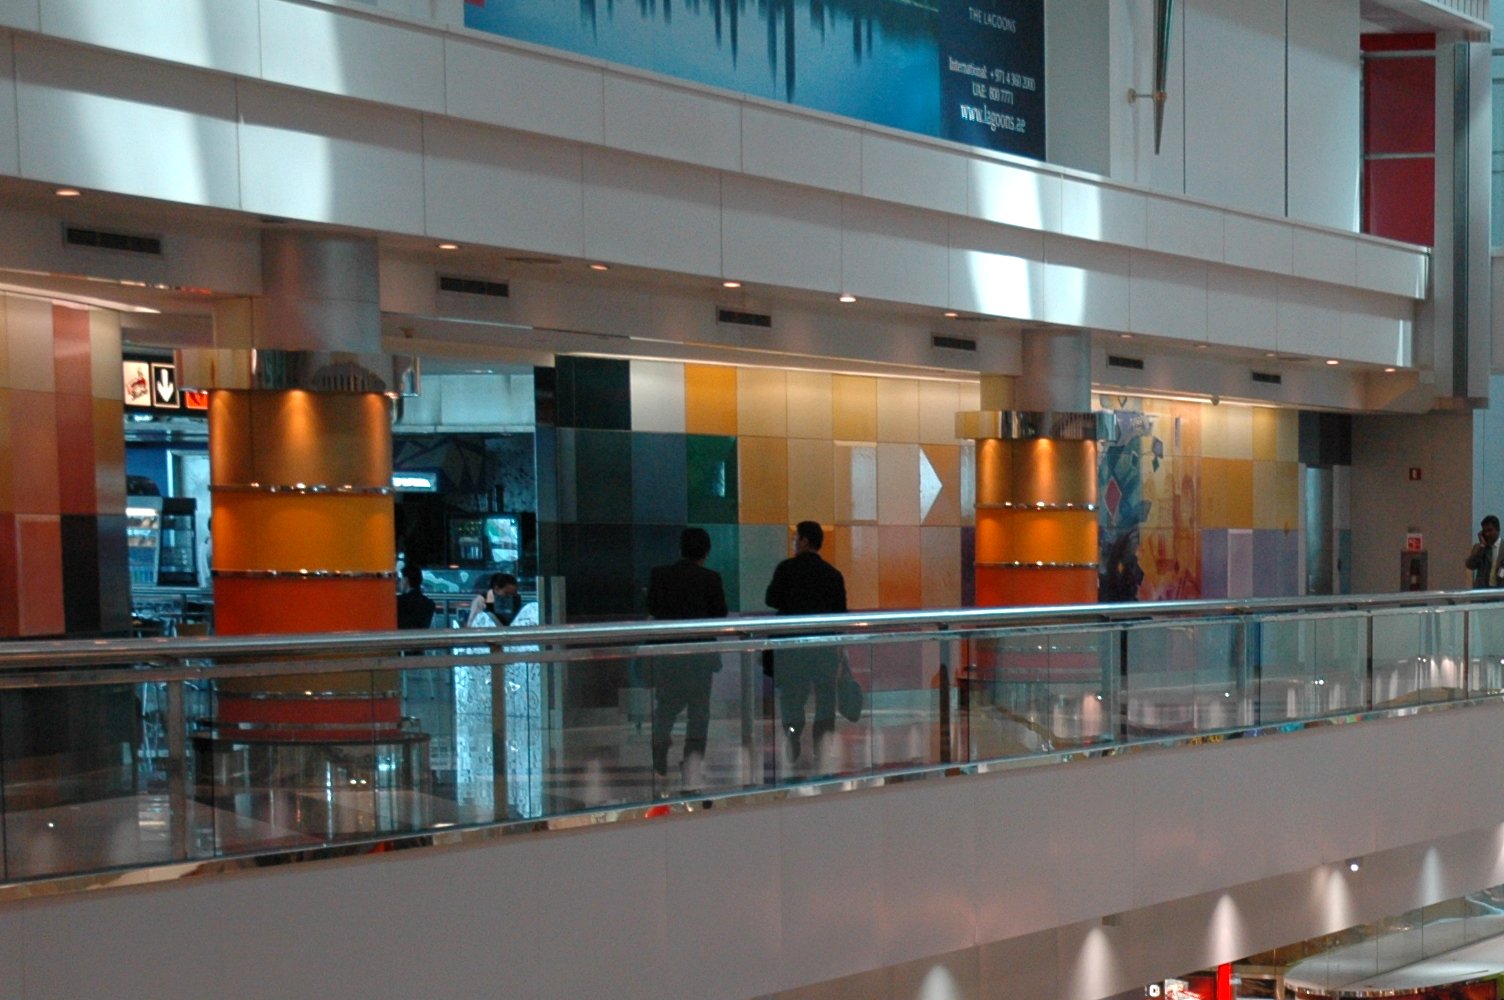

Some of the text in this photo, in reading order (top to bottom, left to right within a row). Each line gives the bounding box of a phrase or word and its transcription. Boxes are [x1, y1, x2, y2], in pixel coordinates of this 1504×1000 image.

[968, 7, 1017, 34] THE LAGOONS
[960, 104, 1027, 133] www.lagoons.ae
